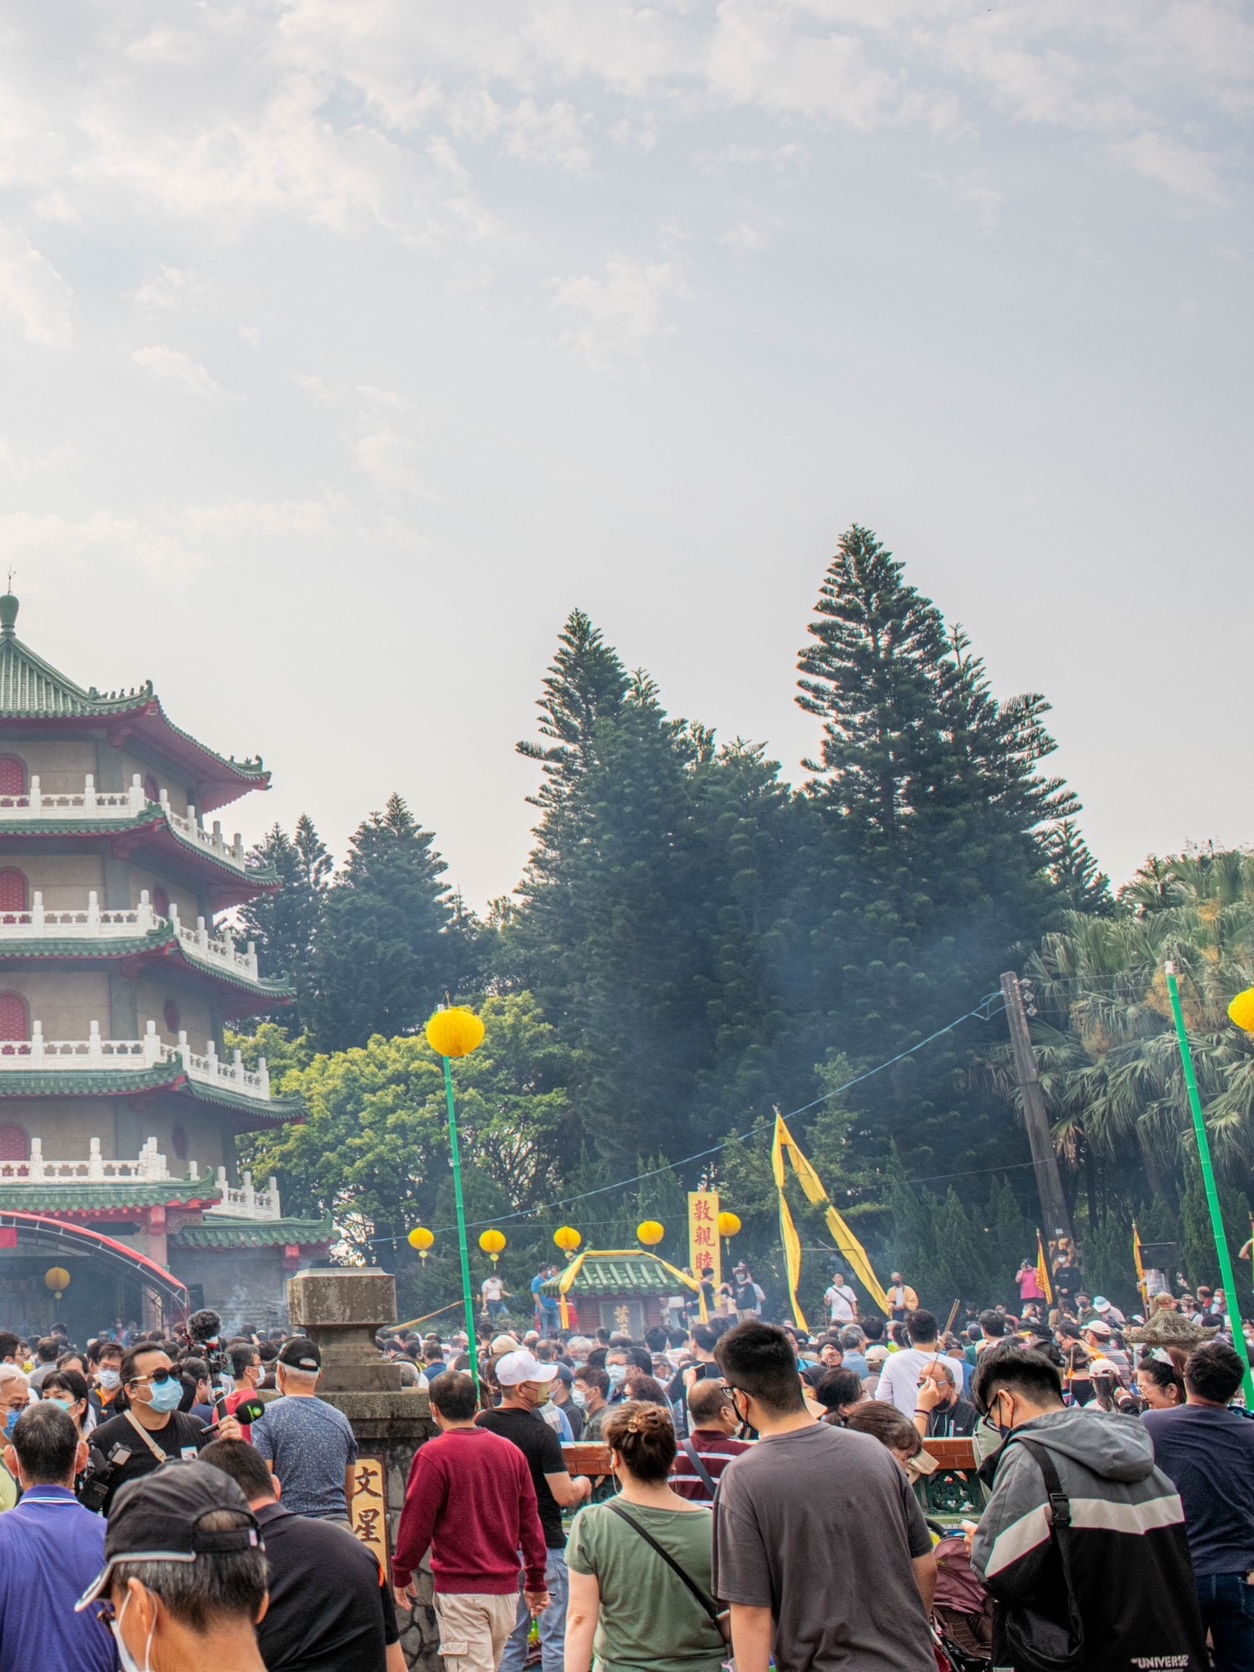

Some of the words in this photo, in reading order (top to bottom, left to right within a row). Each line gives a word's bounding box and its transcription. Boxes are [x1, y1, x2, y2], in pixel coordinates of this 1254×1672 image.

[693, 1200, 716, 1281] 敦親睦
[354, 1466, 382, 1544] 文星
